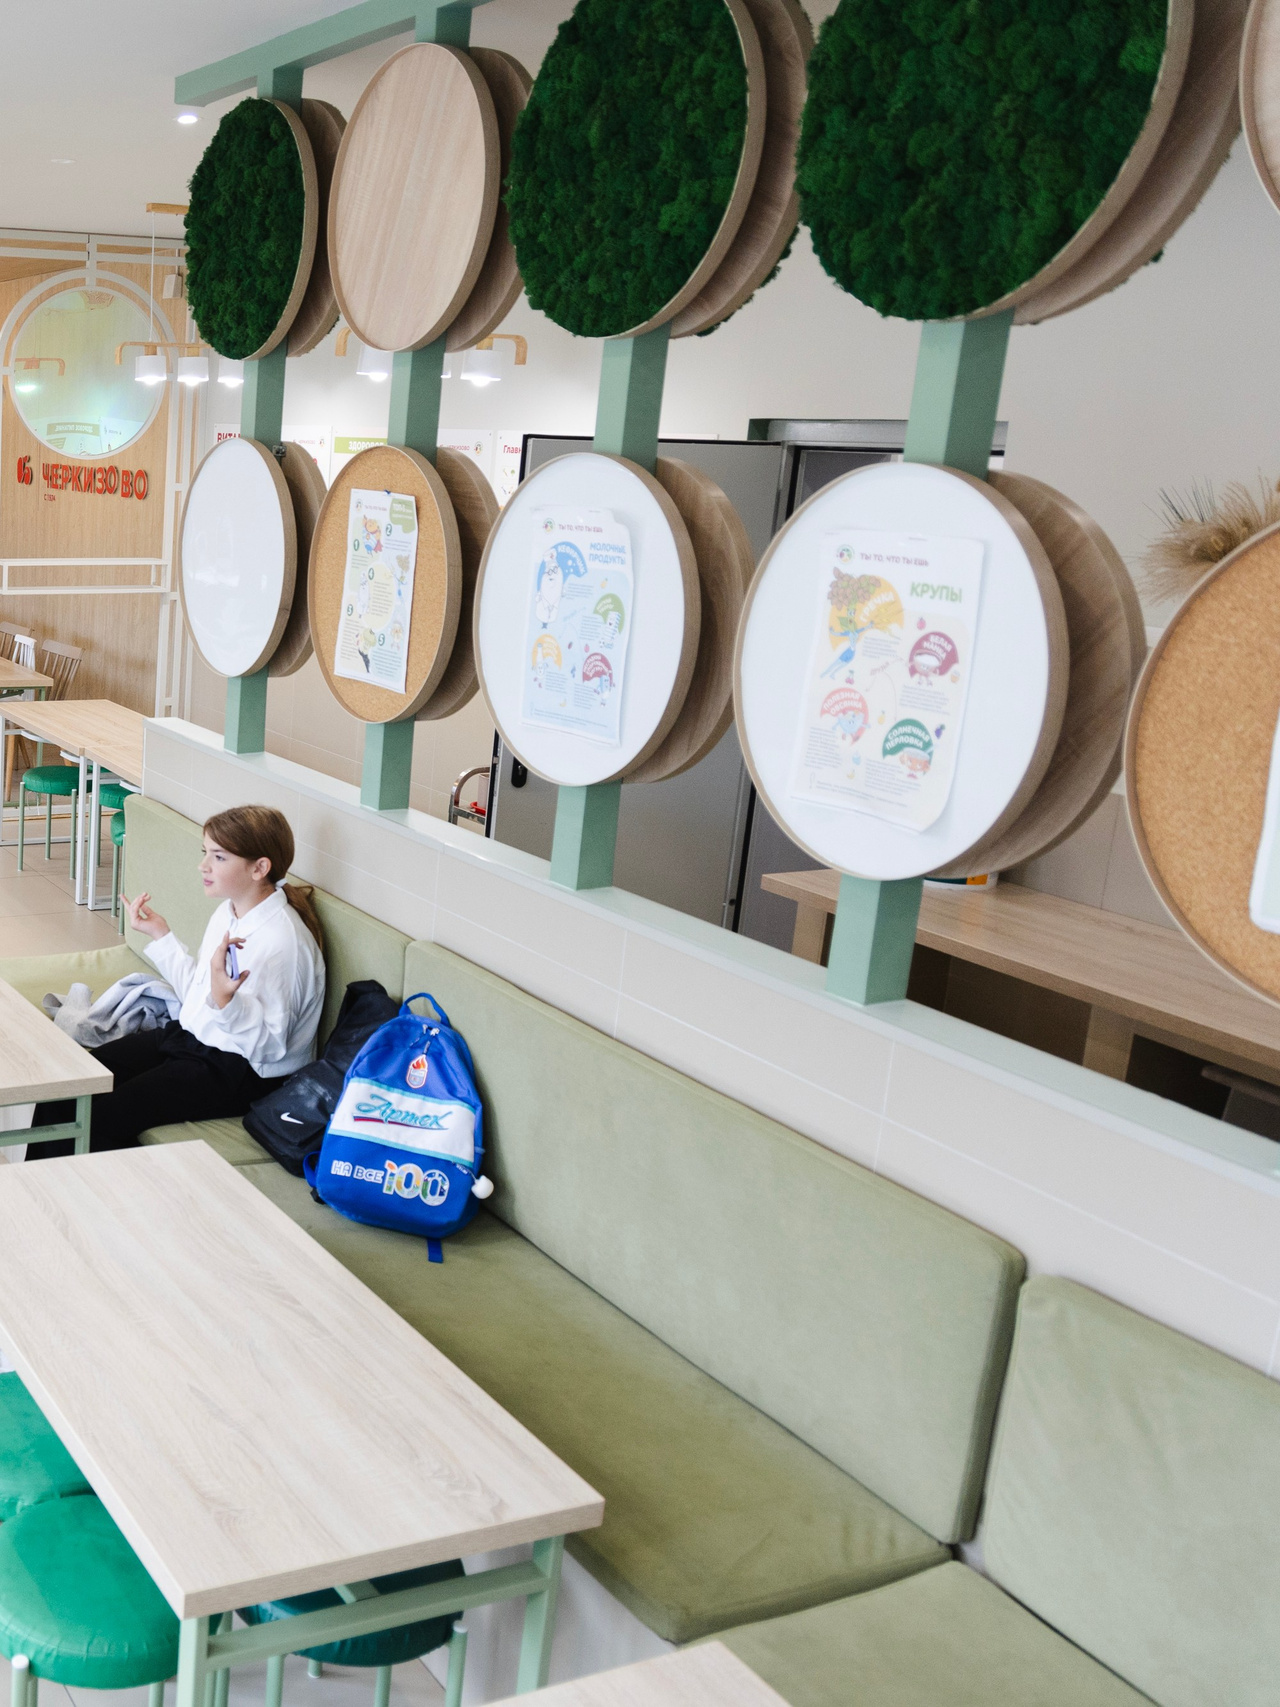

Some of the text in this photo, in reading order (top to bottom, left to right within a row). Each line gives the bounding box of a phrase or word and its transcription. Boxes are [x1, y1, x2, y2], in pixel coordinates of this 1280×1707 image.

[42, 463, 148, 500] ЧЕРКИЗОВО
[590, 542, 626, 554] МОЛОЧНЫЕ
[589, 553, 626, 565] ПРОДУКТЫ
[860, 552, 872, 560] ТЫ
[886, 555, 901, 564] ЧТО
[902, 557, 913, 565] ТЫ
[910, 581, 962, 603] КРУПЫ
[823, 691, 860, 710] ПОЛЕЗНАЯ
[885, 735, 923, 750] ПЕРЛОВКА
[888, 725, 930, 742] СОЛНЕЧНАЯ
[355, 1094, 453, 1128] Артек
[331, 1160, 352, 1177] НА
[353, 1165, 385, 1184] ВСЕ
[382, 1159, 450, 1207] 100
